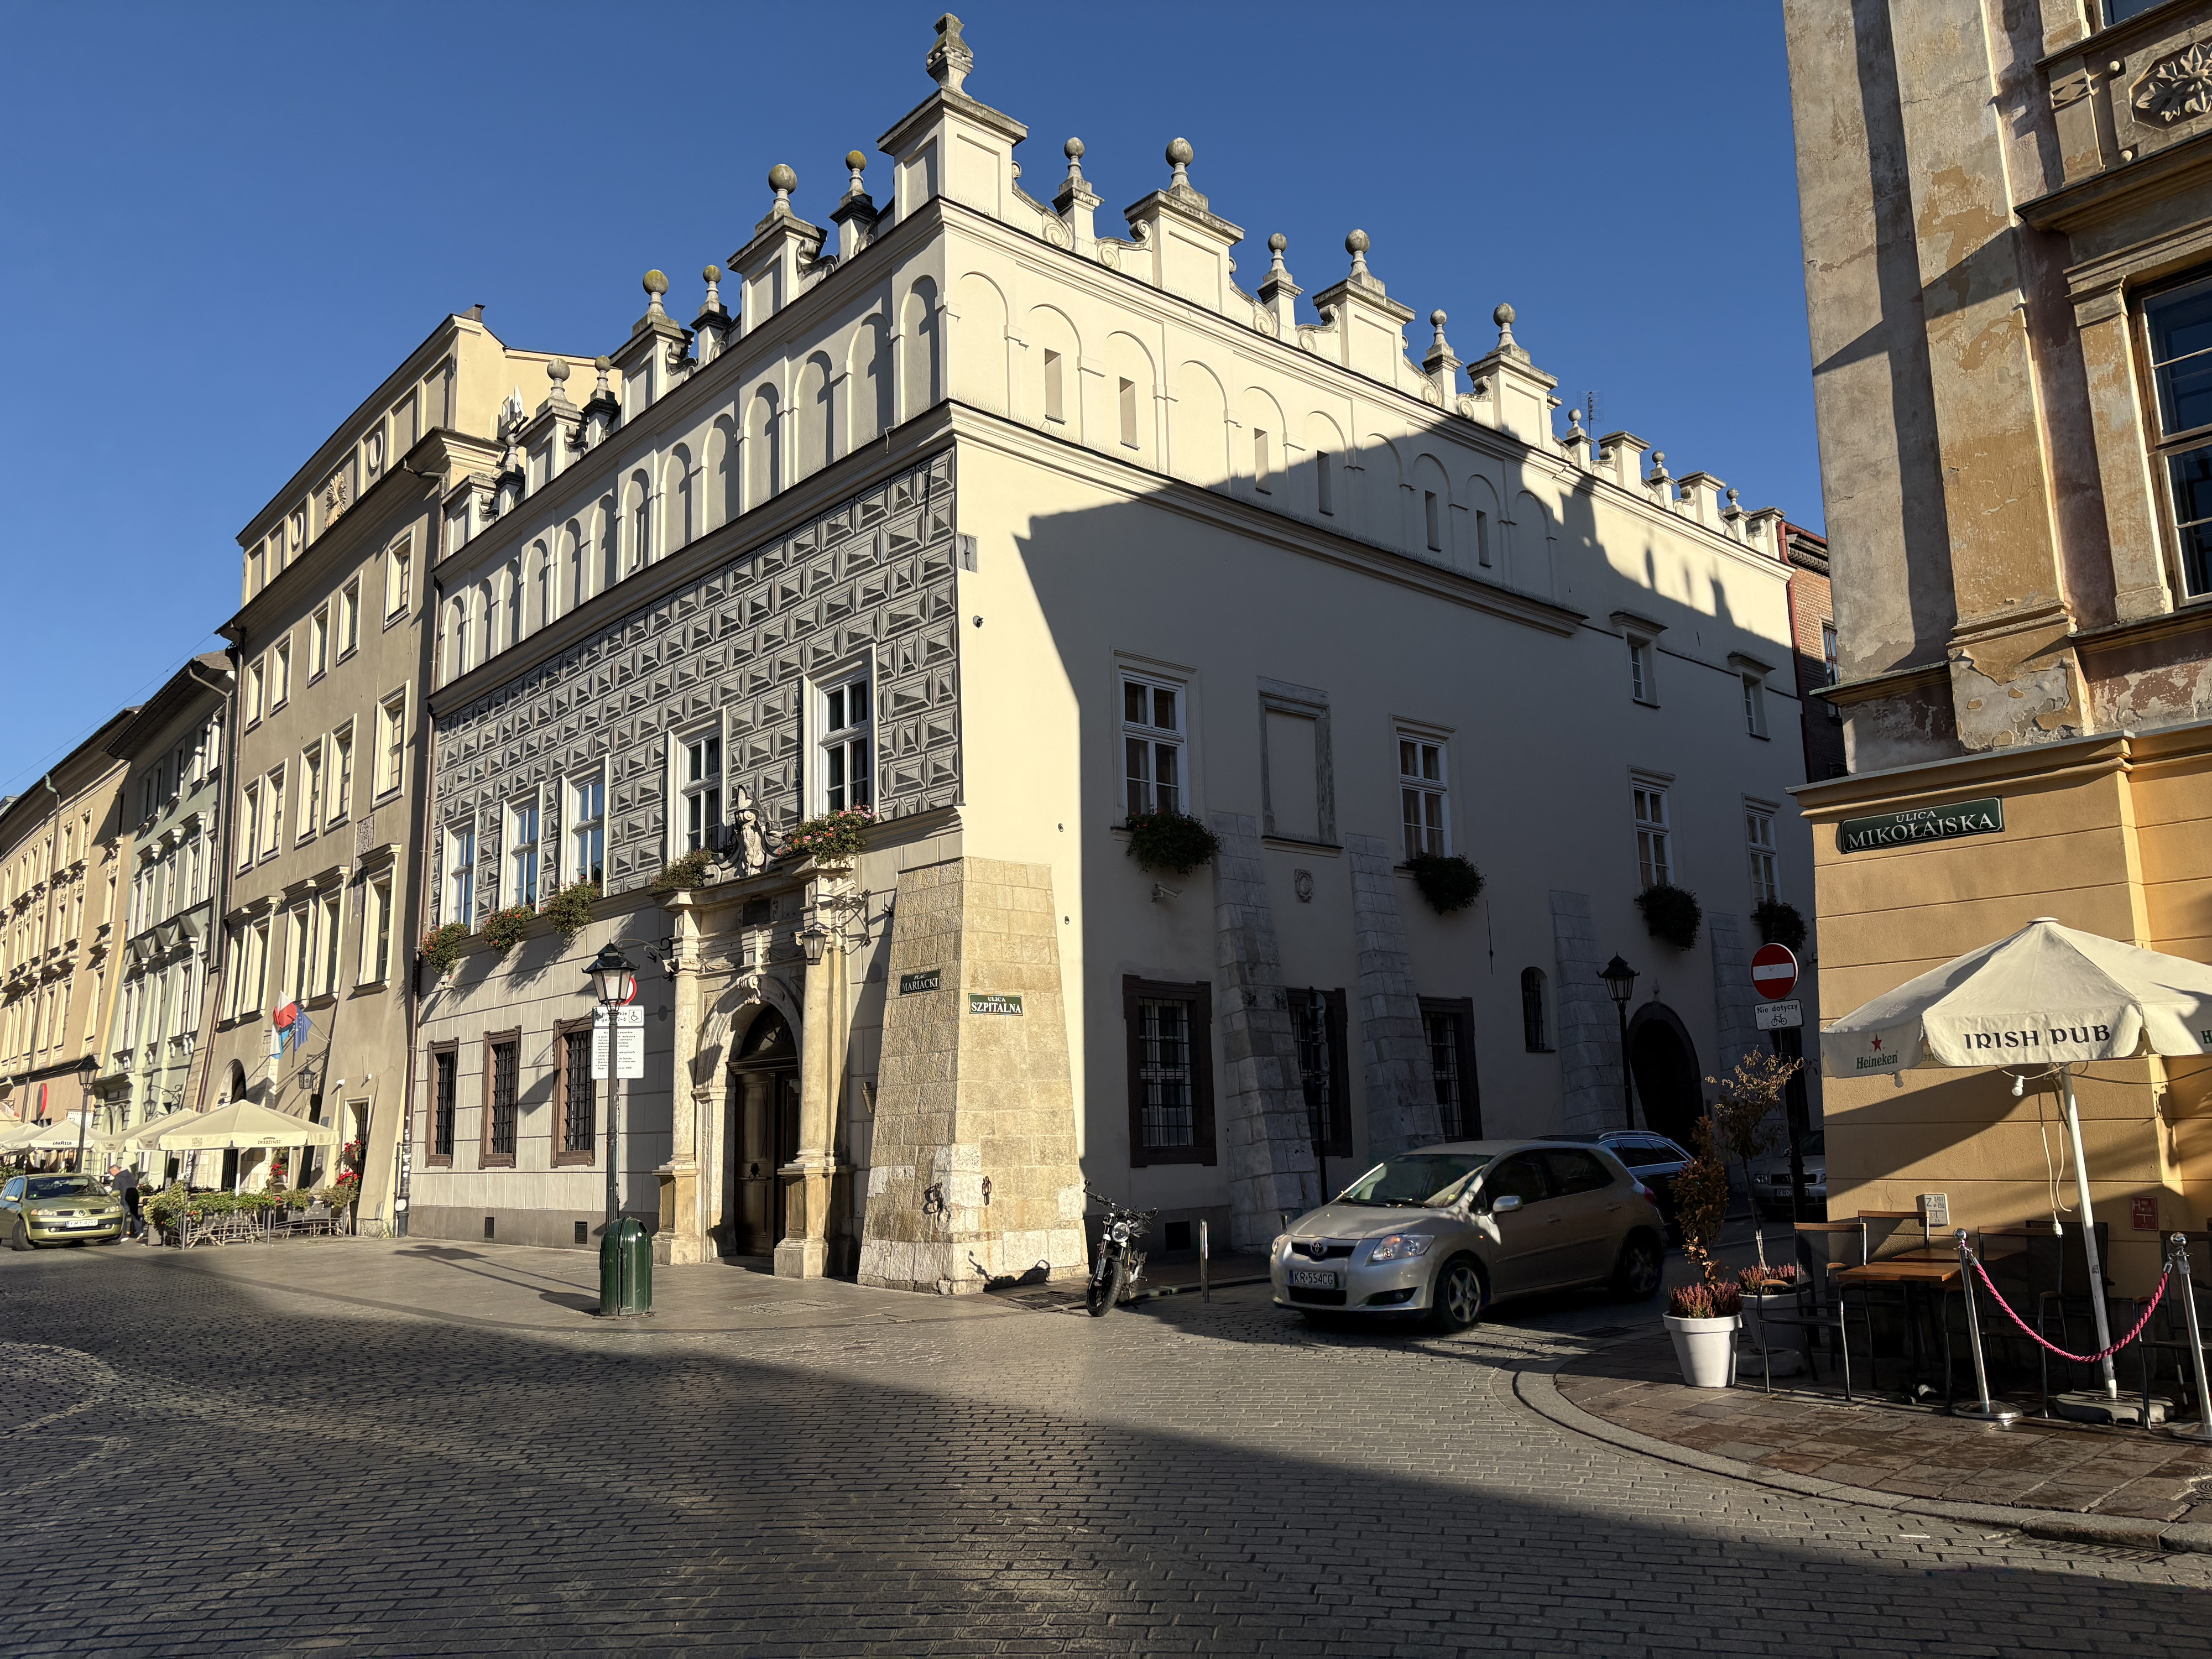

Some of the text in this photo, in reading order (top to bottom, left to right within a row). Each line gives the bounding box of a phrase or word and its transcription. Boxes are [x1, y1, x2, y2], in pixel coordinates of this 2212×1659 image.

[1896, 810, 1937, 823] ULICA
[1847, 813, 1996, 849] MIKOŁAJSKA
[901, 977, 938, 992] MARIACKI
[971, 1001, 1021, 1013] SZPITALNA
[1772, 1004, 1798, 1013] dotyczy
[1963, 1025, 2110, 1049] IRISH PUB
[1856, 1053, 1898, 1069] Heineken
[1294, 1271, 1306, 1283] KR
